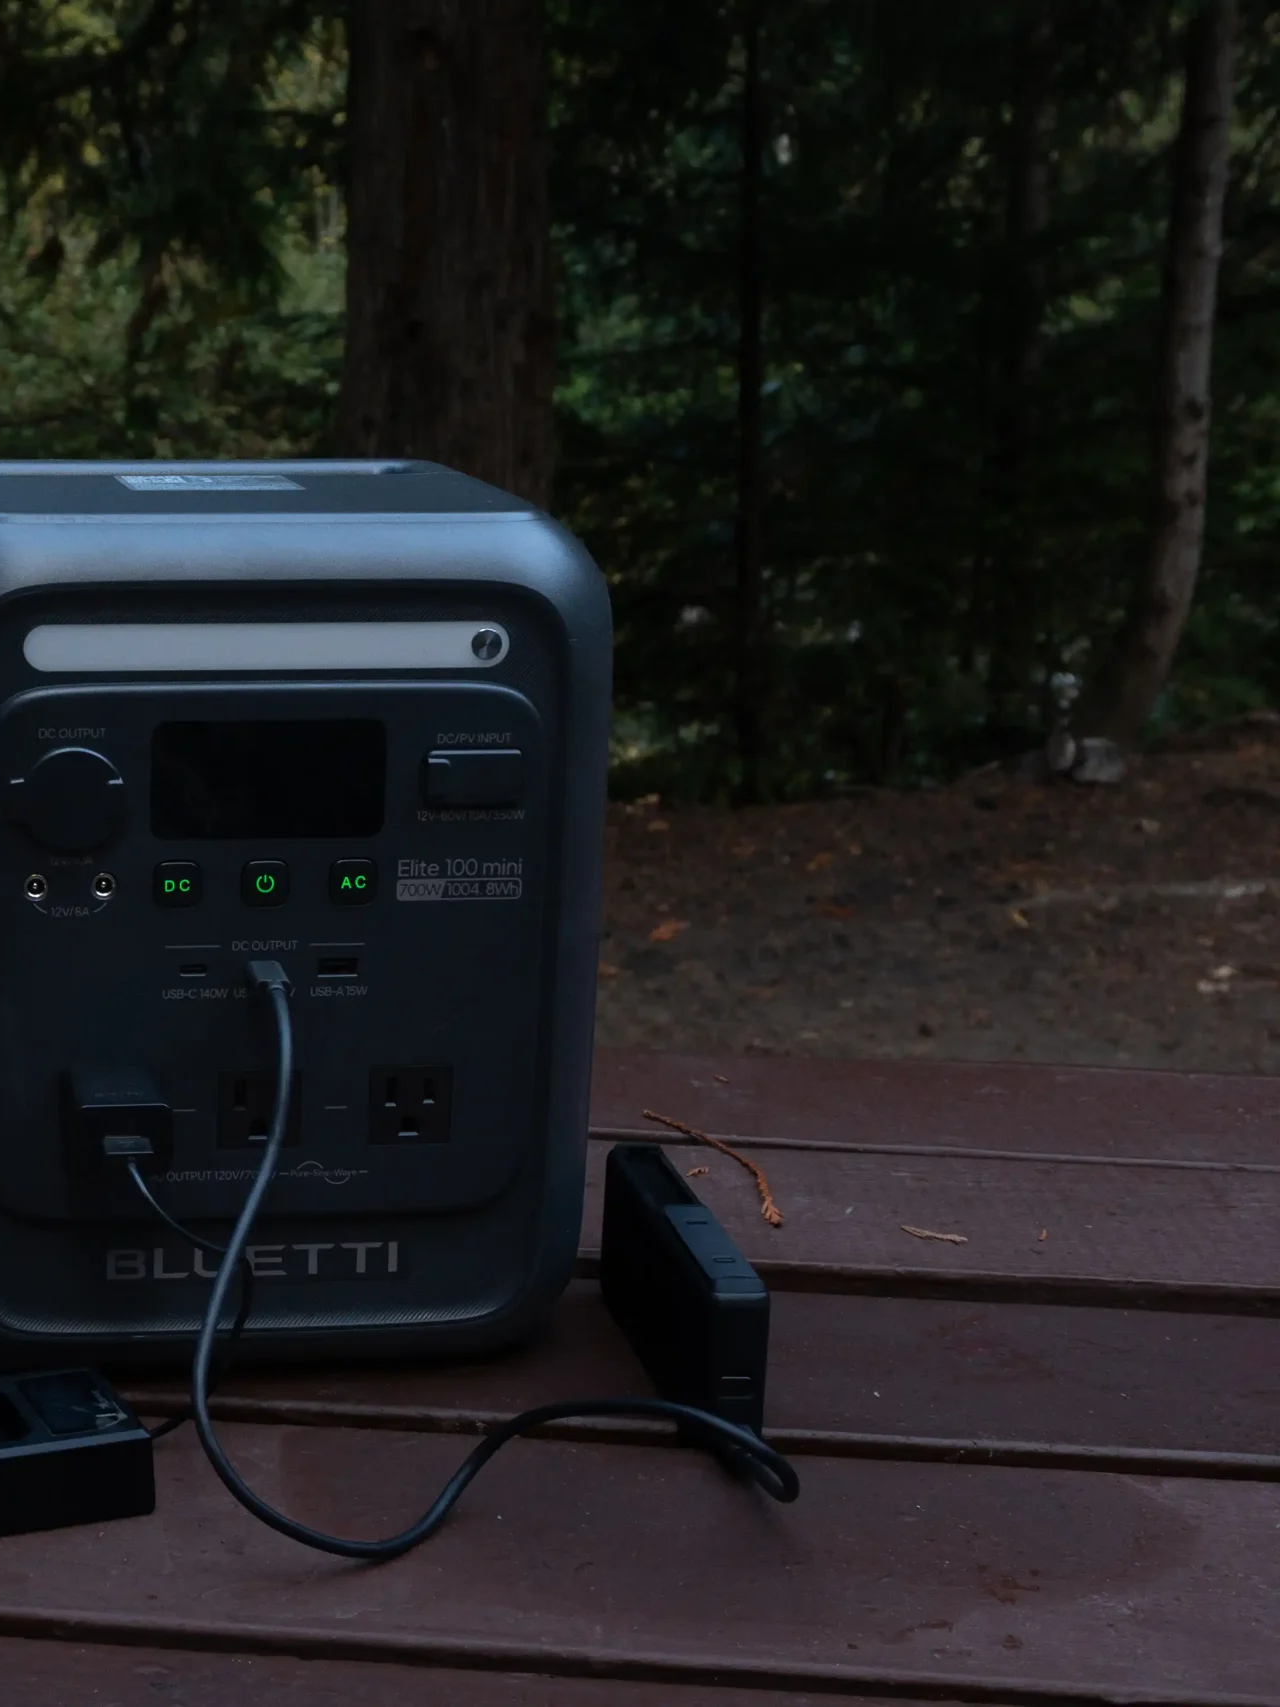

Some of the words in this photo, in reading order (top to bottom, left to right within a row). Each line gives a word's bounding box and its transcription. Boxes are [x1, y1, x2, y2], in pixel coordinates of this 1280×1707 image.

[38, 728, 56, 739] DC
[60, 727, 106, 739] OUTPUT
[436, 733, 475, 745] DC/PV
[477, 732, 512, 744] INPUT
[397, 859, 440, 877] Elite
[445, 858, 479, 876] 100
[482, 857, 523, 877] mini
[163, 879, 192, 892] DC
[340, 875, 368, 889] AC
[399, 883, 442, 897] 700W
[50, 906, 90, 917] 12V/8A
[231, 941, 249, 951] DC
[252, 940, 298, 951] OUTPUT
[162, 988, 196, 1000] USB-C
[200, 988, 229, 999] 140W
[310, 986, 345, 997] USB-A
[347, 986, 368, 997] 15W
[166, 1170, 212, 1182] OUTPUT
